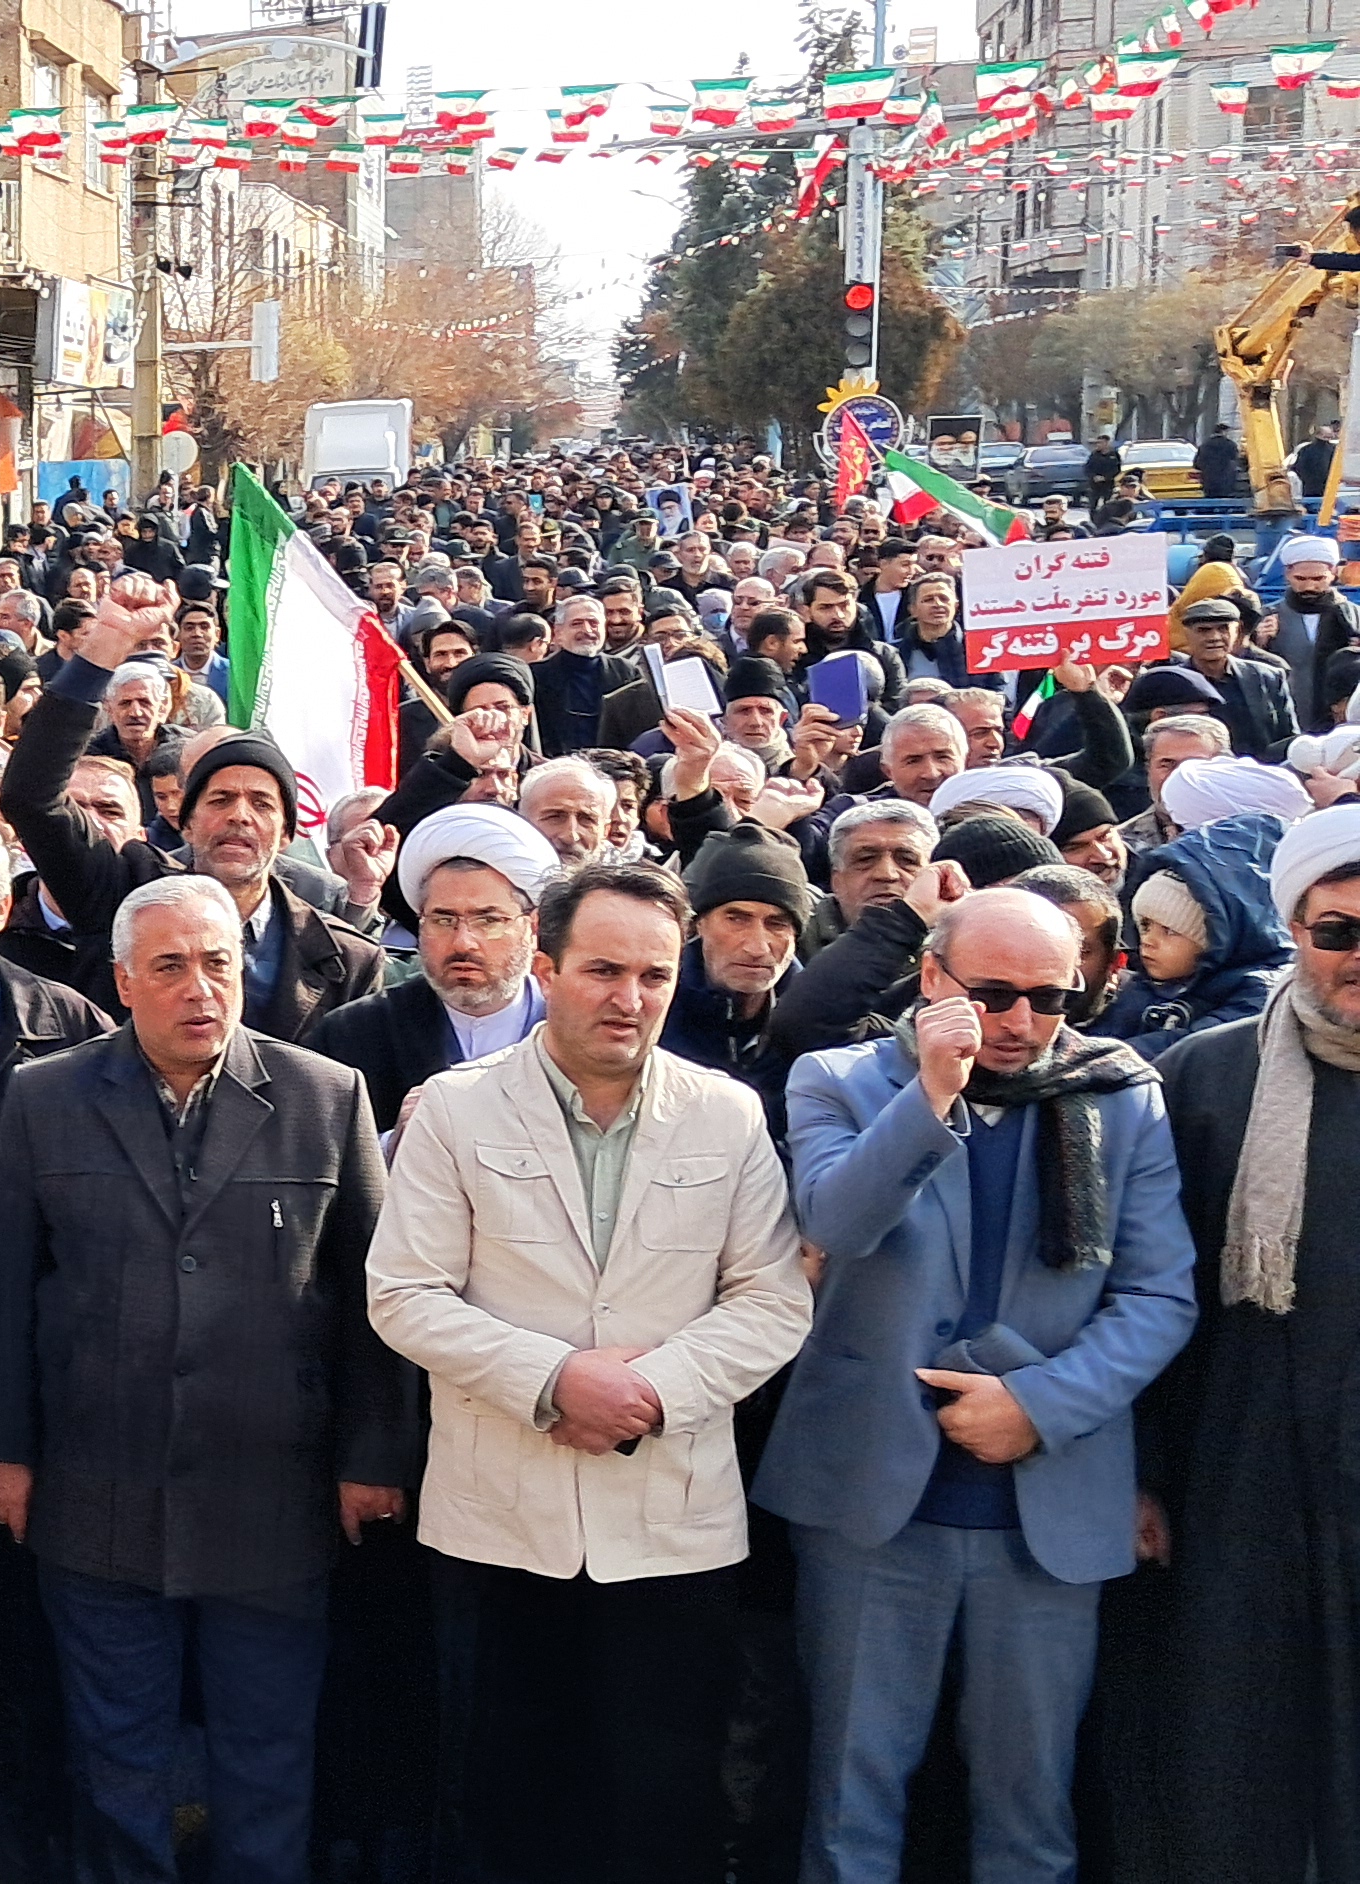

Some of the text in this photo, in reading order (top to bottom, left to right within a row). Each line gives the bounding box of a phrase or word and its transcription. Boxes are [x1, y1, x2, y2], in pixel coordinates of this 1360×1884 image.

[1014, 546, 1111, 581] فتنه گران
[969, 598, 1027, 617] هستند
[1071, 588, 1109, 614] تنفر
[1114, 590, 1162, 610] مورد
[1069, 631, 1092, 661] بر
[1098, 622, 1161, 658] مرگ
